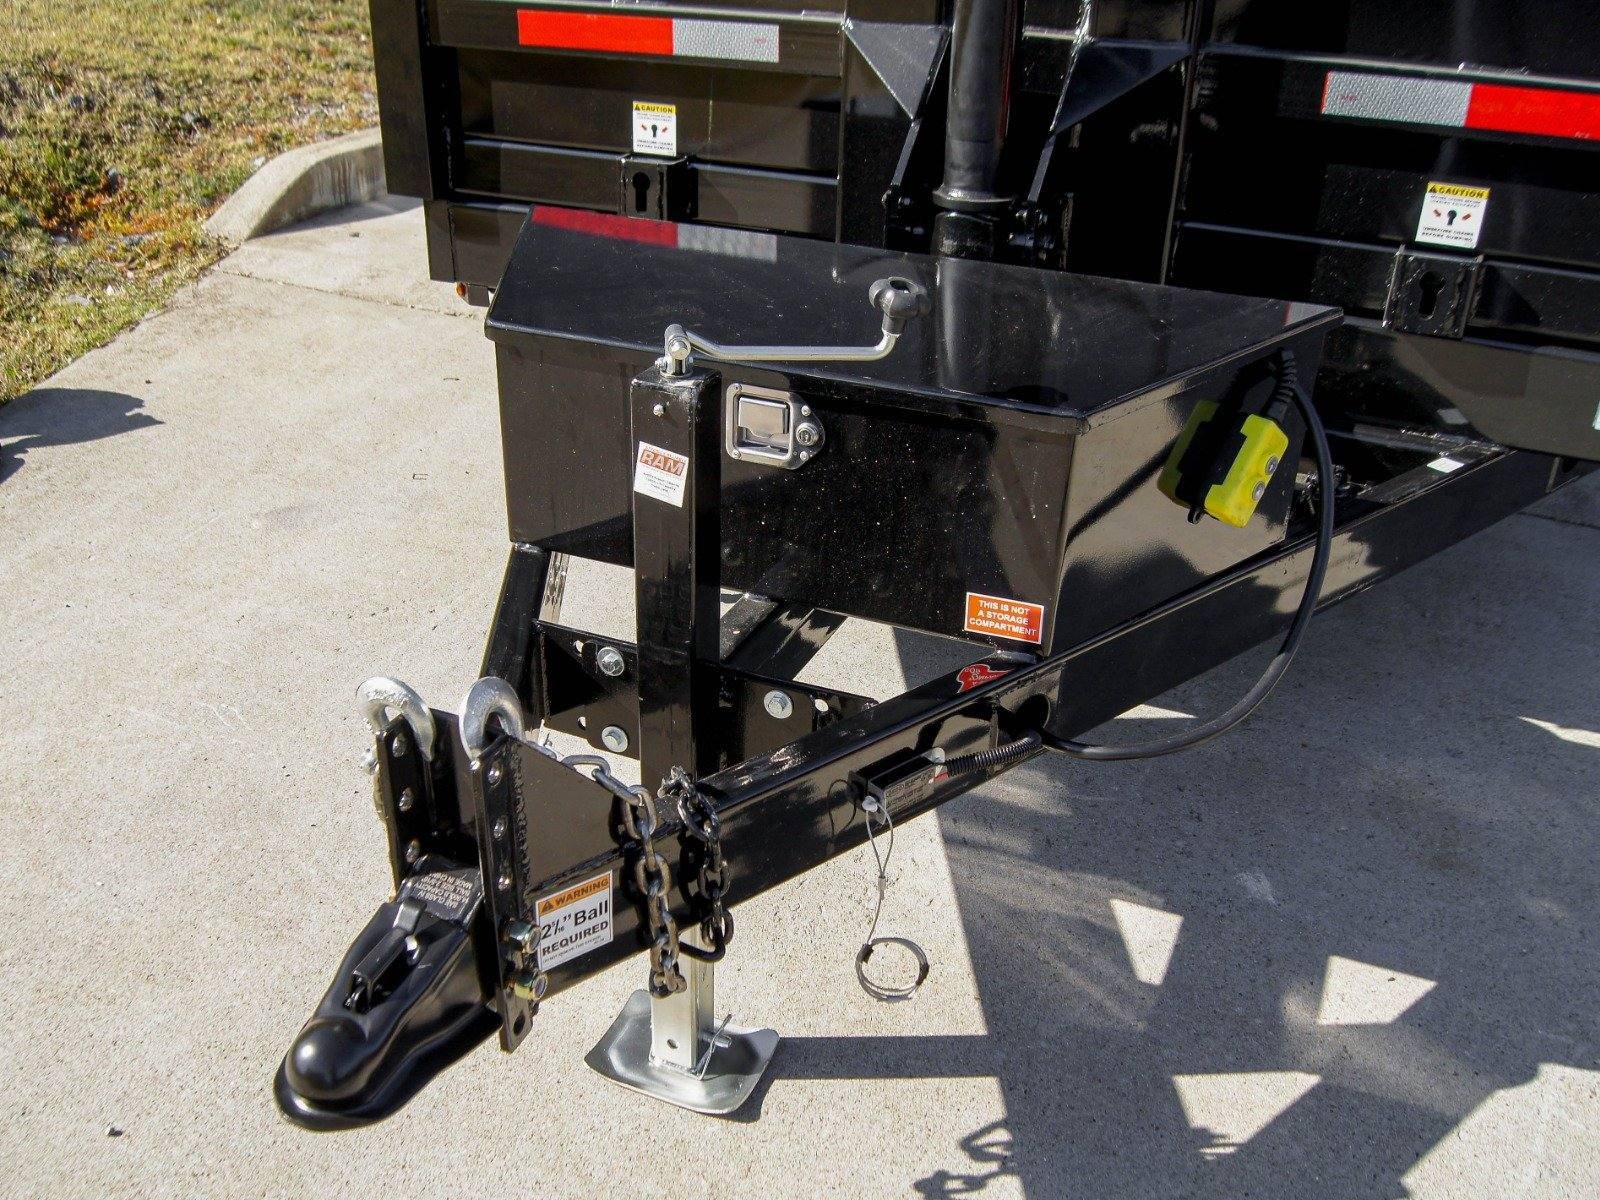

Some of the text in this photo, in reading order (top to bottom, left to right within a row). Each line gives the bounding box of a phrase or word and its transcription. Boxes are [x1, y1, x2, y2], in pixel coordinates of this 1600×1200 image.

[641, 105, 673, 113] CAUTION
[1438, 186, 1484, 198] CAUTION
[641, 451, 685, 476] RAM
[979, 600, 999, 609] THIS
[1011, 605, 1030, 615] NOT
[977, 609, 1028, 625] A STORAGE
[969, 618, 1036, 636] COMPARTMENT
[556, 880, 608, 906] WARNING
[574, 900, 608, 927] Ball
[542, 921, 608, 956] REQUIRED
